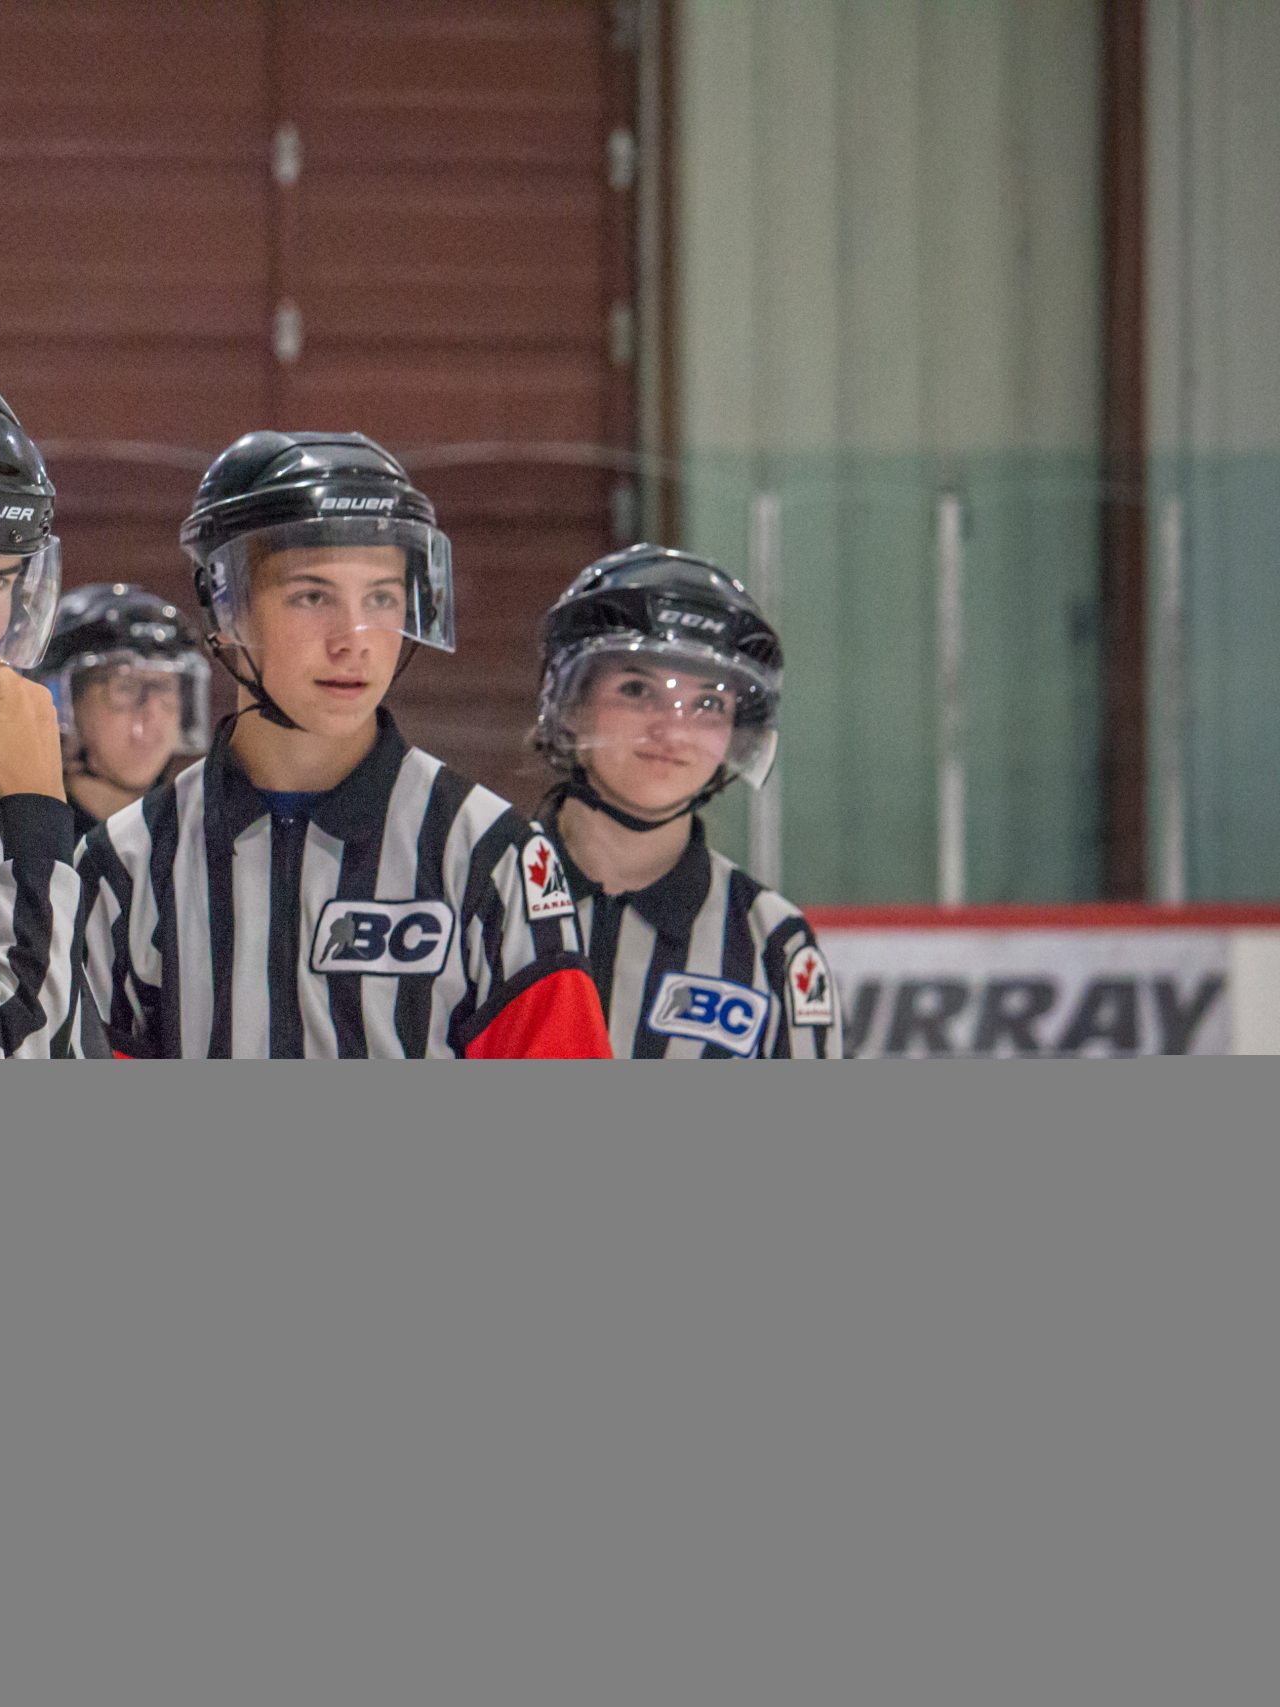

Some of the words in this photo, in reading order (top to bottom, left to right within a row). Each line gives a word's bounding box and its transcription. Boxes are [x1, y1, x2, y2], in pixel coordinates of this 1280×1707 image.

[320, 497, 396, 510] BAUER
[330, 911, 442, 963] BC
[675, 986, 754, 1035] BC
